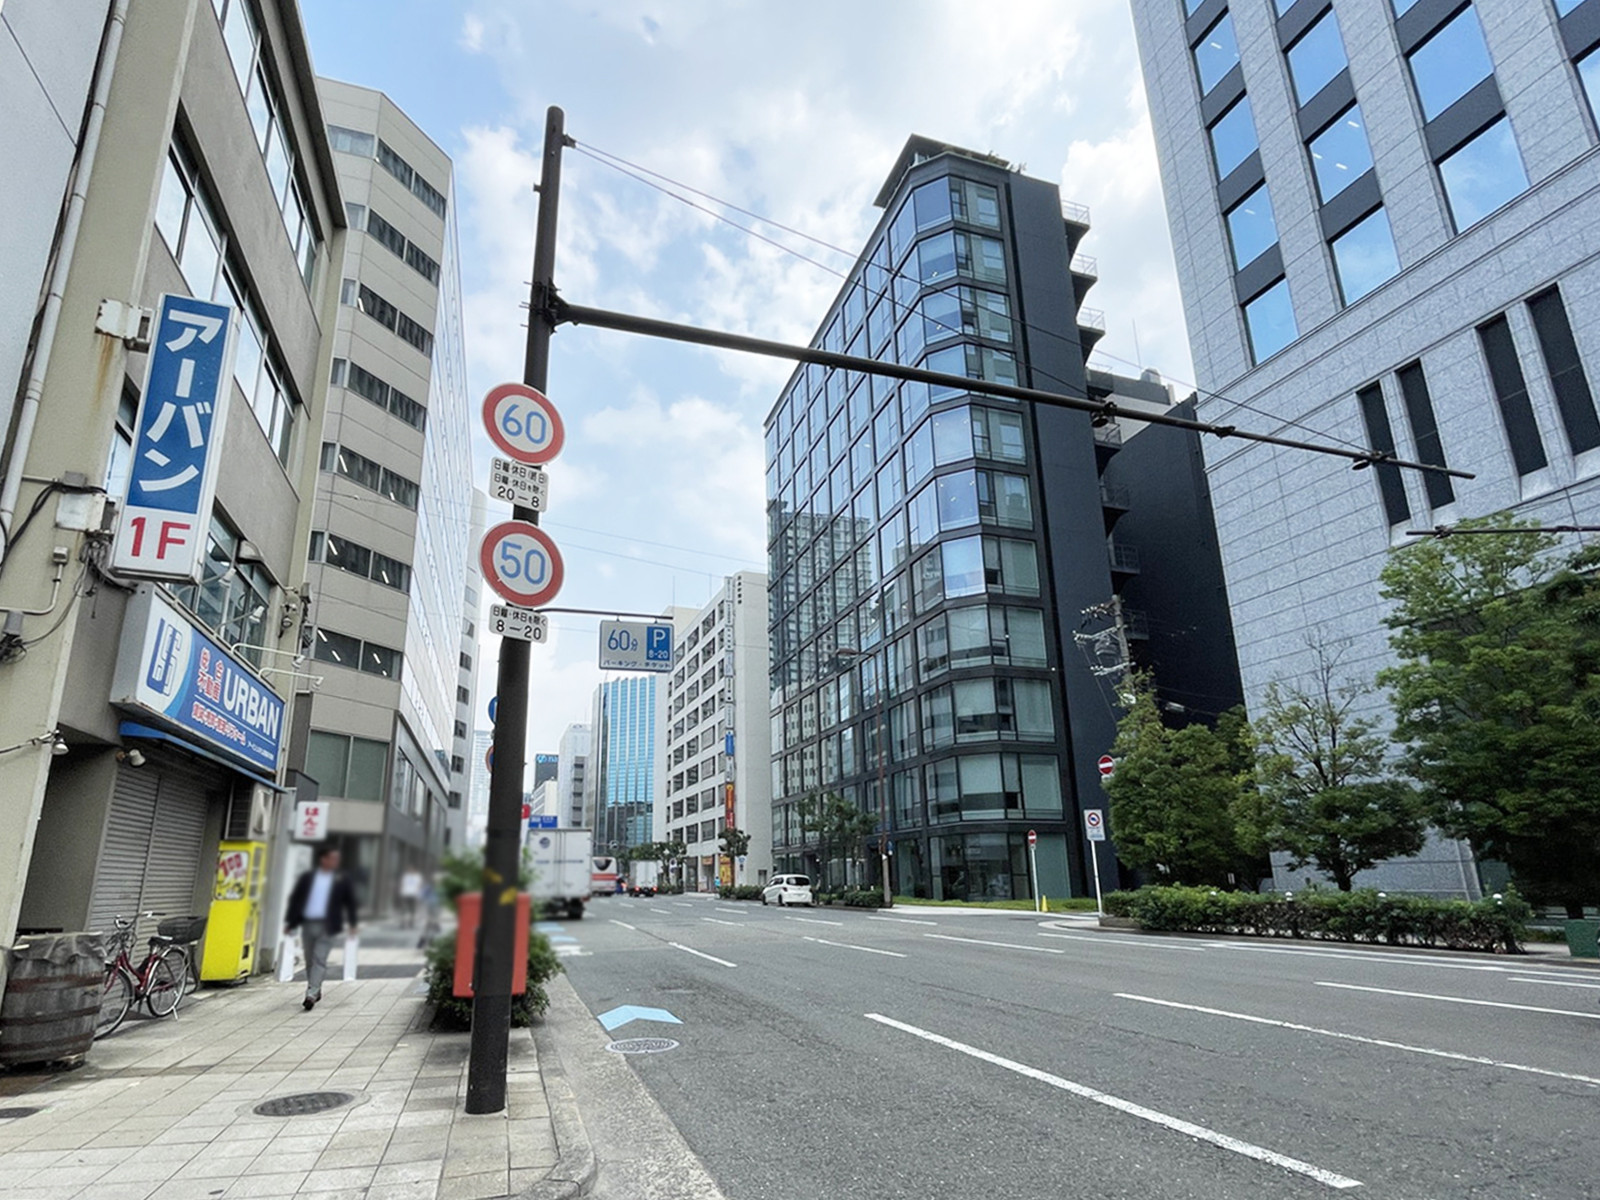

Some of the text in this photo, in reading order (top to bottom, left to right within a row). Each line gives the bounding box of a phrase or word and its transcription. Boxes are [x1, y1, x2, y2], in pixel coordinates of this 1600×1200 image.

[138, 309, 225, 492] アーバン
[502, 404, 547, 444] 60
[130, 516, 191, 560] 1F
[500, 540, 546, 585] 50
[653, 629, 666, 649] P
[223, 667, 280, 740] URBAN
